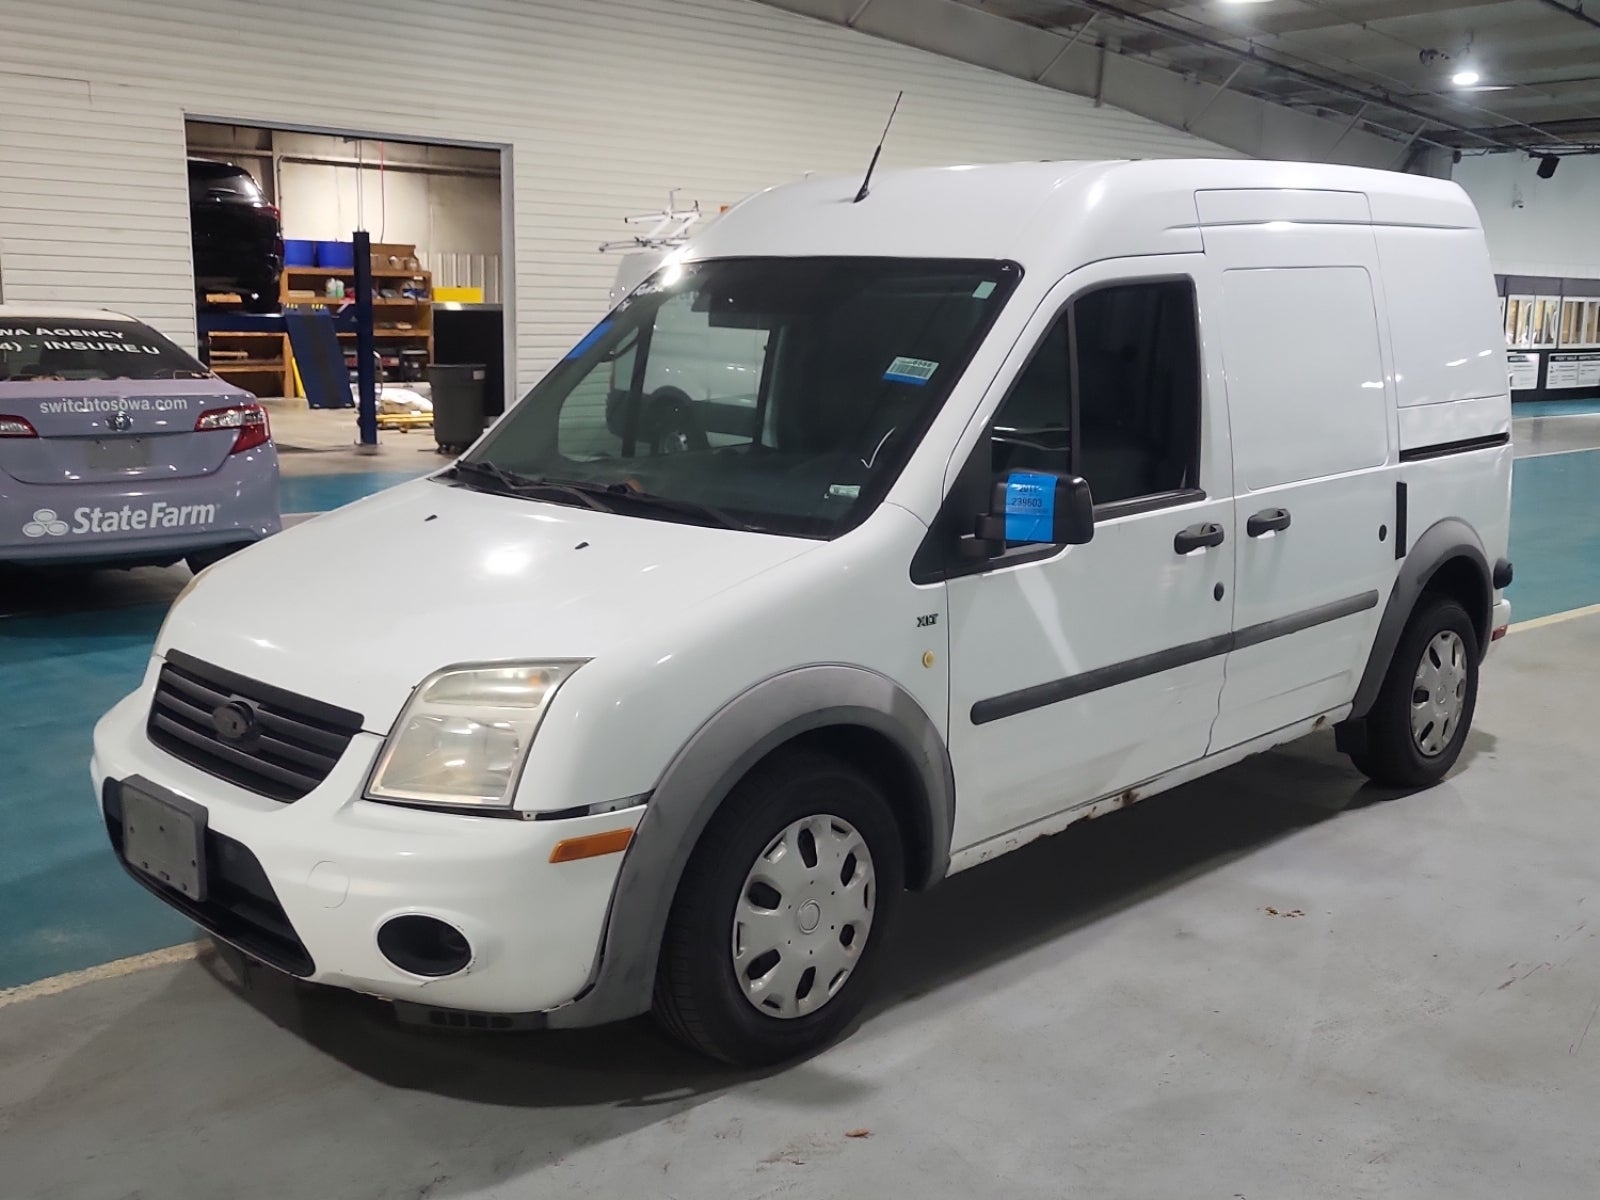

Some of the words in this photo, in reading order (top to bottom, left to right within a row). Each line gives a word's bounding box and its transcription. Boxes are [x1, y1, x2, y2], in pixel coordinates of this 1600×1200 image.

[36, 327, 123, 339] AGENCY
[44, 341, 141, 353] INSURE
[40, 398, 188, 414] switchtosowa.com
[916, 613, 938, 627] XLT
